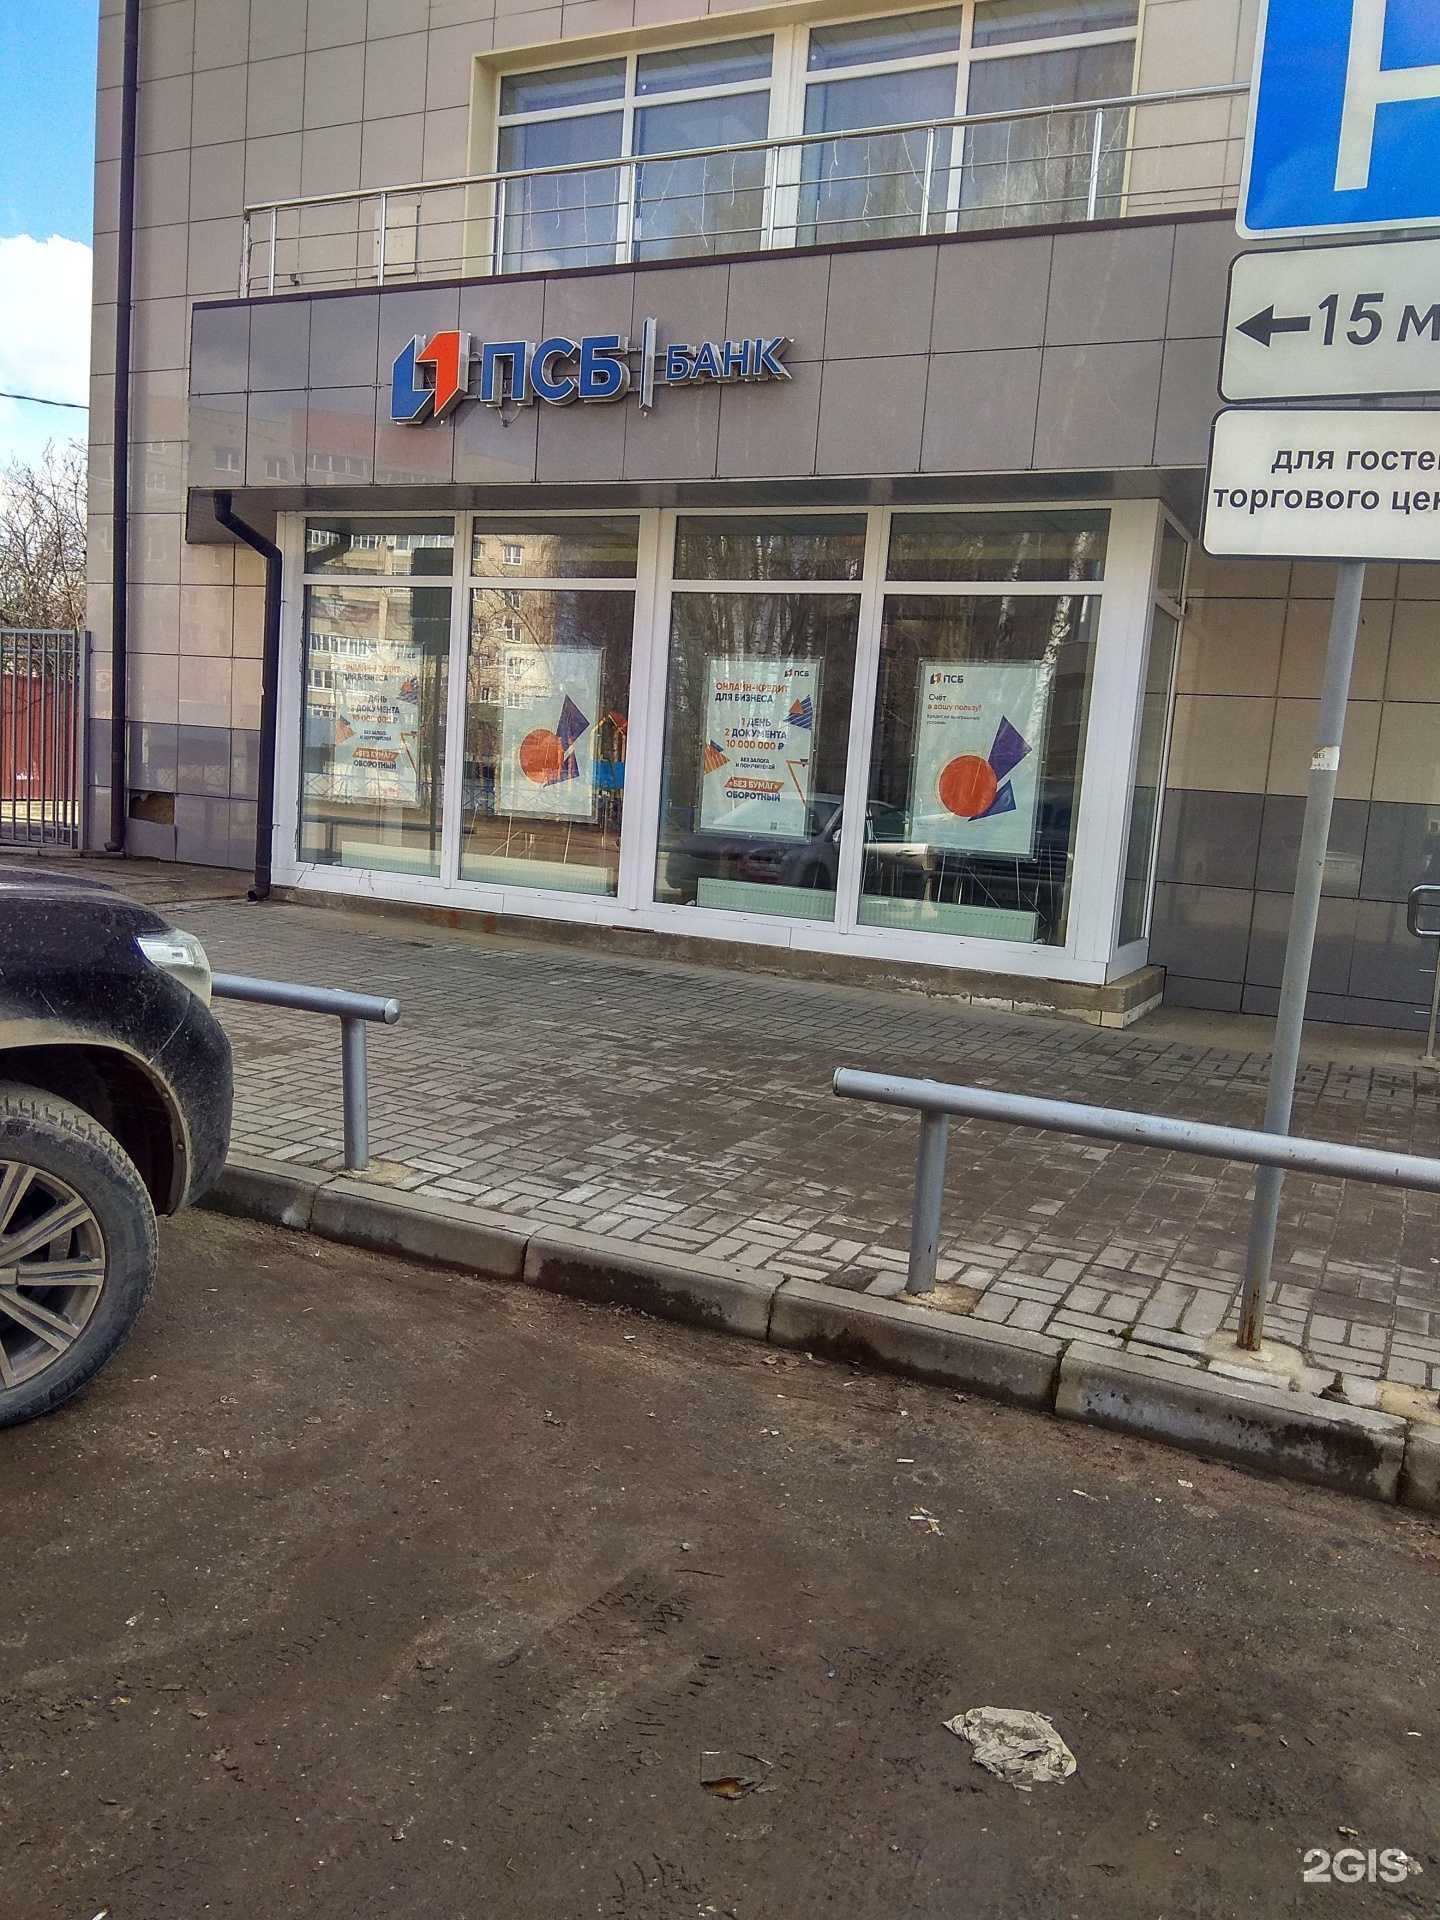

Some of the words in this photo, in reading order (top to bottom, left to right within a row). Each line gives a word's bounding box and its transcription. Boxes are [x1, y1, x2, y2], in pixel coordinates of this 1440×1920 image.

[1318, 292, 1384, 346] 15
[480, 335, 629, 404] ПСБ
[665, 337, 791, 384] БАНК
[1271, 450, 1335, 474] для
[1346, 450, 1440, 471] госте
[1213, 488, 1380, 514] торгового
[943, 674, 964, 684] ПСБ
[715, 692, 733, 702] ДЛЯ
[735, 693, 773, 703] БИЗНЕСА
[747, 717, 772, 727] ДЕНЬ
[724, 728, 730, 736] 2
[732, 728, 787, 739] ДОКУМЕНТА
[727, 740, 736, 748] 10
[738, 740, 756, 748] 000
[758, 741, 776, 749] 000
[726, 790, 781, 802] ОБОРОТНЫЙ
